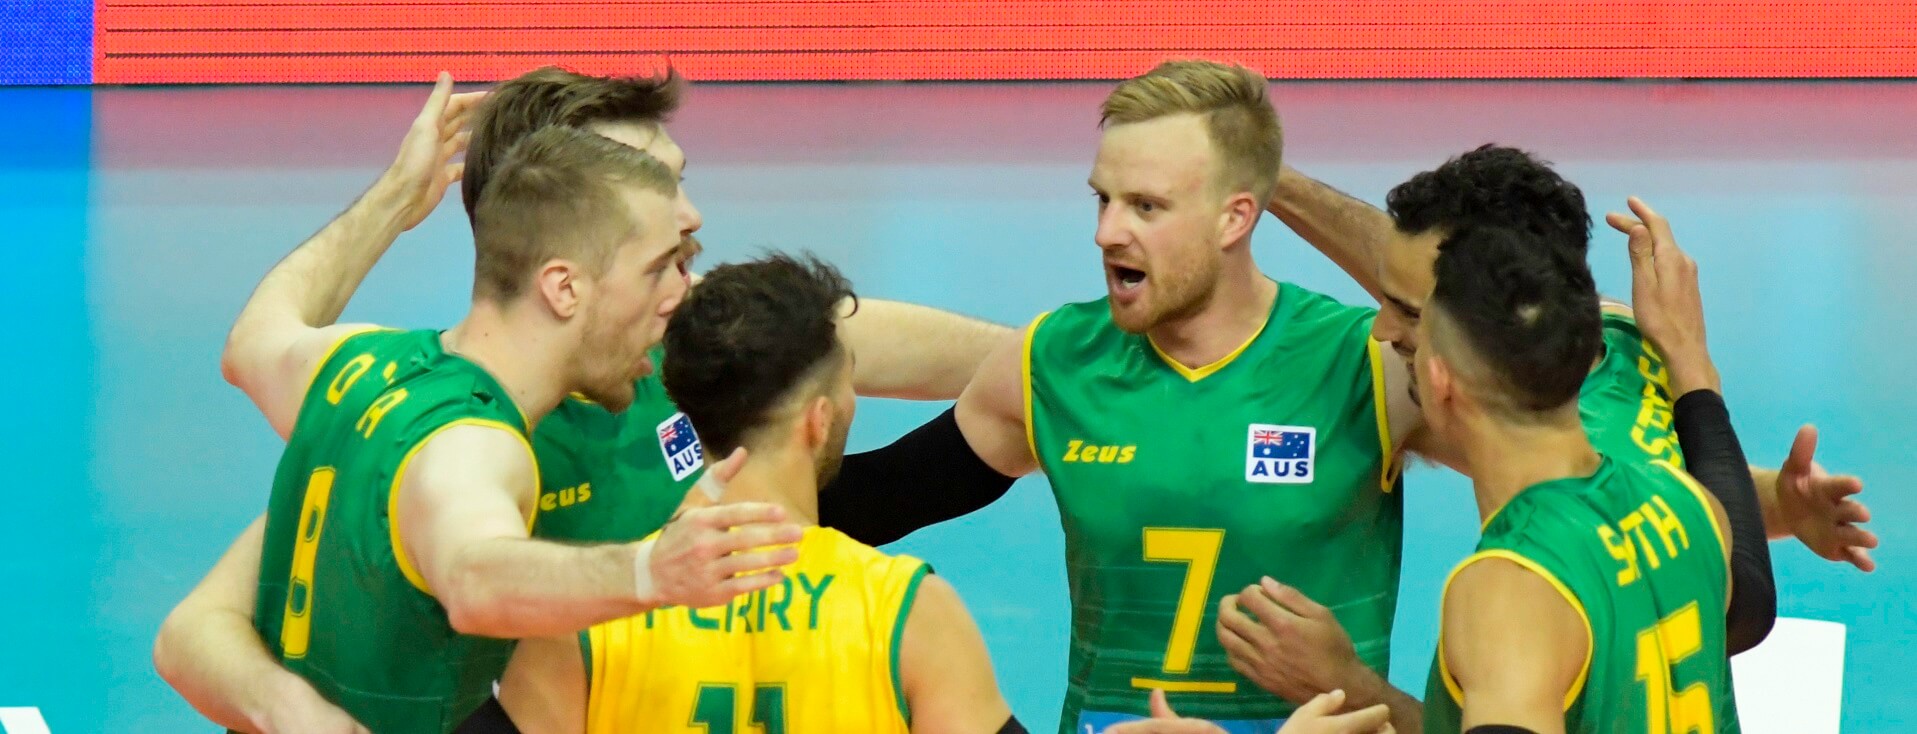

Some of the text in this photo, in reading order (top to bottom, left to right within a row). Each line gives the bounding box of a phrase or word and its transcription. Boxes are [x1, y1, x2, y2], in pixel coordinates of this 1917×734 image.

[672, 443, 704, 475] AUS
[1062, 439, 1137, 463] Zeus
[1251, 460, 1309, 477] AUS
[540, 482, 592, 511] eus
[280, 466, 337, 659] 8
[645, 572, 836, 633] RRY
[1142, 526, 1226, 674] 7
[1635, 599, 1716, 734] 15
